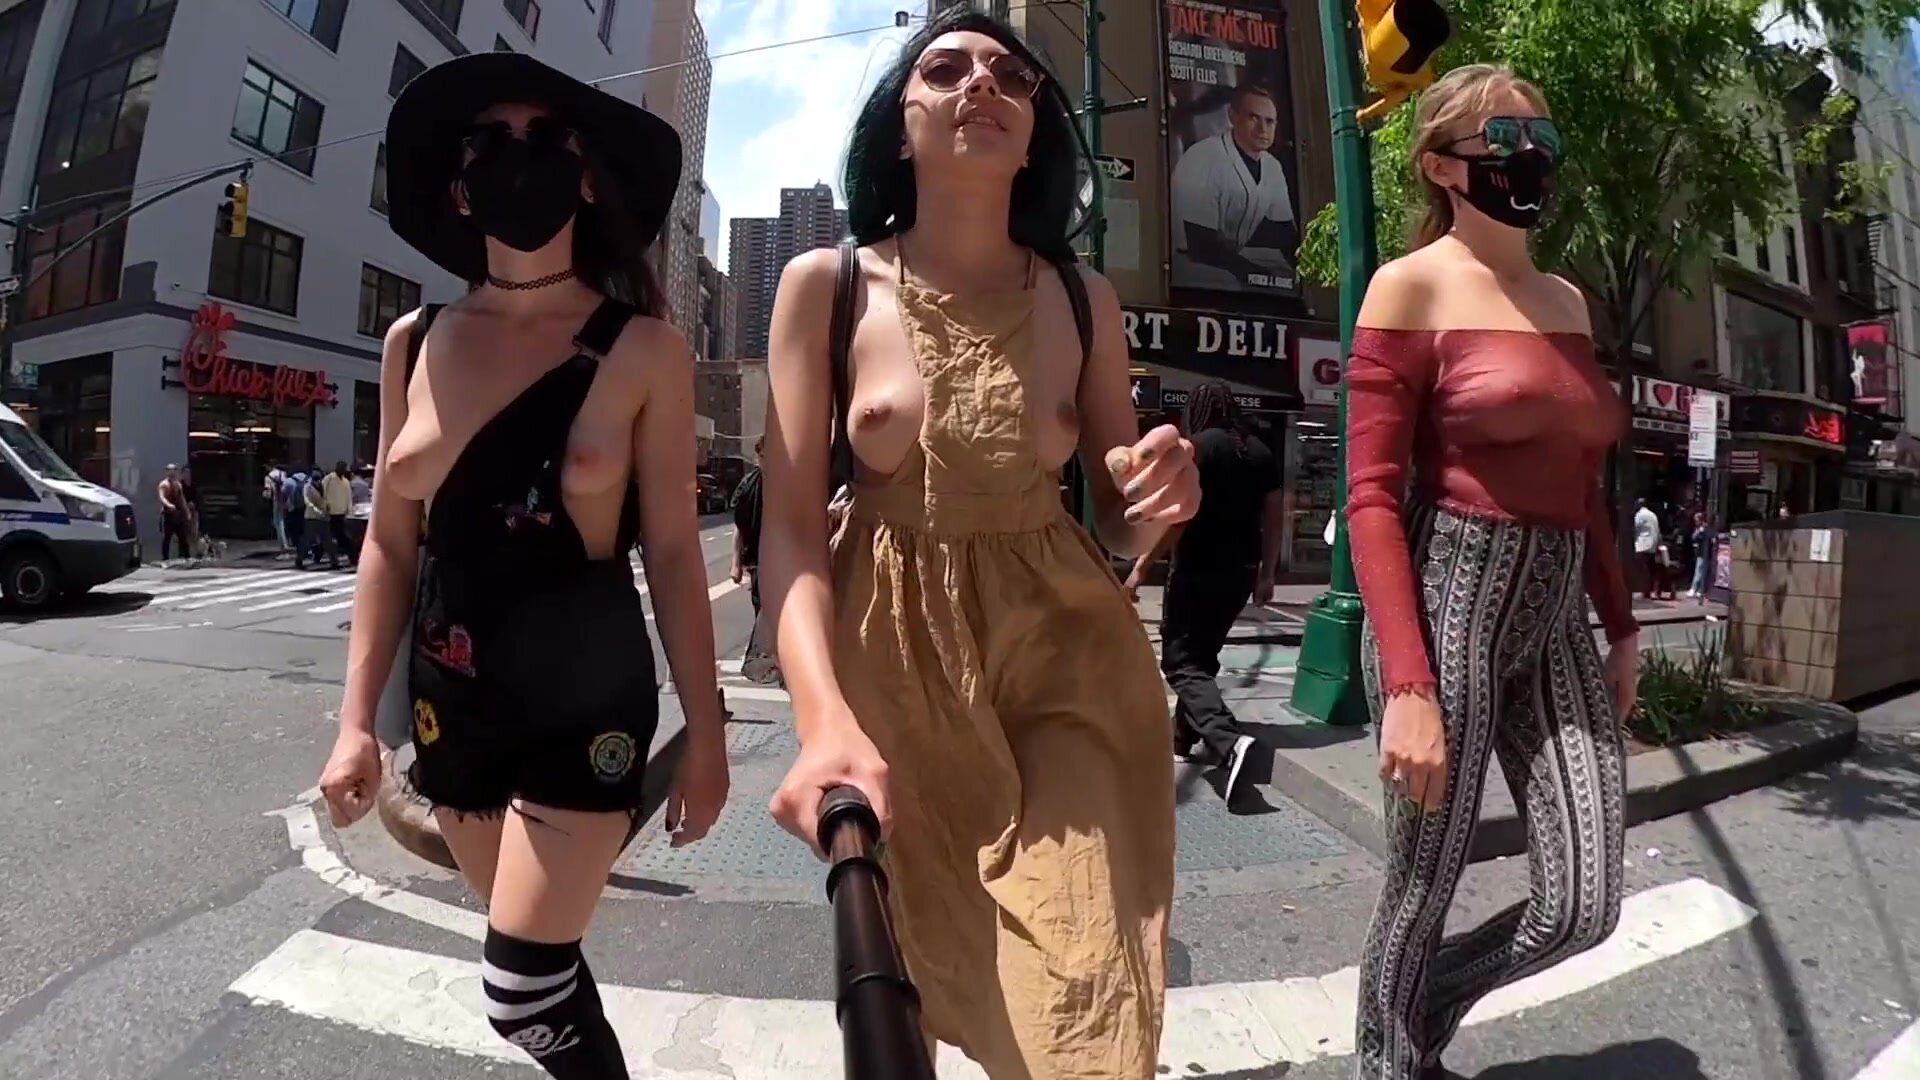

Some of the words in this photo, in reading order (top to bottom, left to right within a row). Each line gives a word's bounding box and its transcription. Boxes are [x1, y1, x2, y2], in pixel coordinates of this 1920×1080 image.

[1169, 5, 1210, 37] TAKE
[1214, 14, 1244, 43] ME
[1247, 19, 1278, 49] OUT
[1168, 40, 1202, 59] RICHARD
[1170, 64, 1194, 81] SCOTT
[1196, 67, 1217, 85] ELLIS
[1197, 316, 1288, 360] DELI
